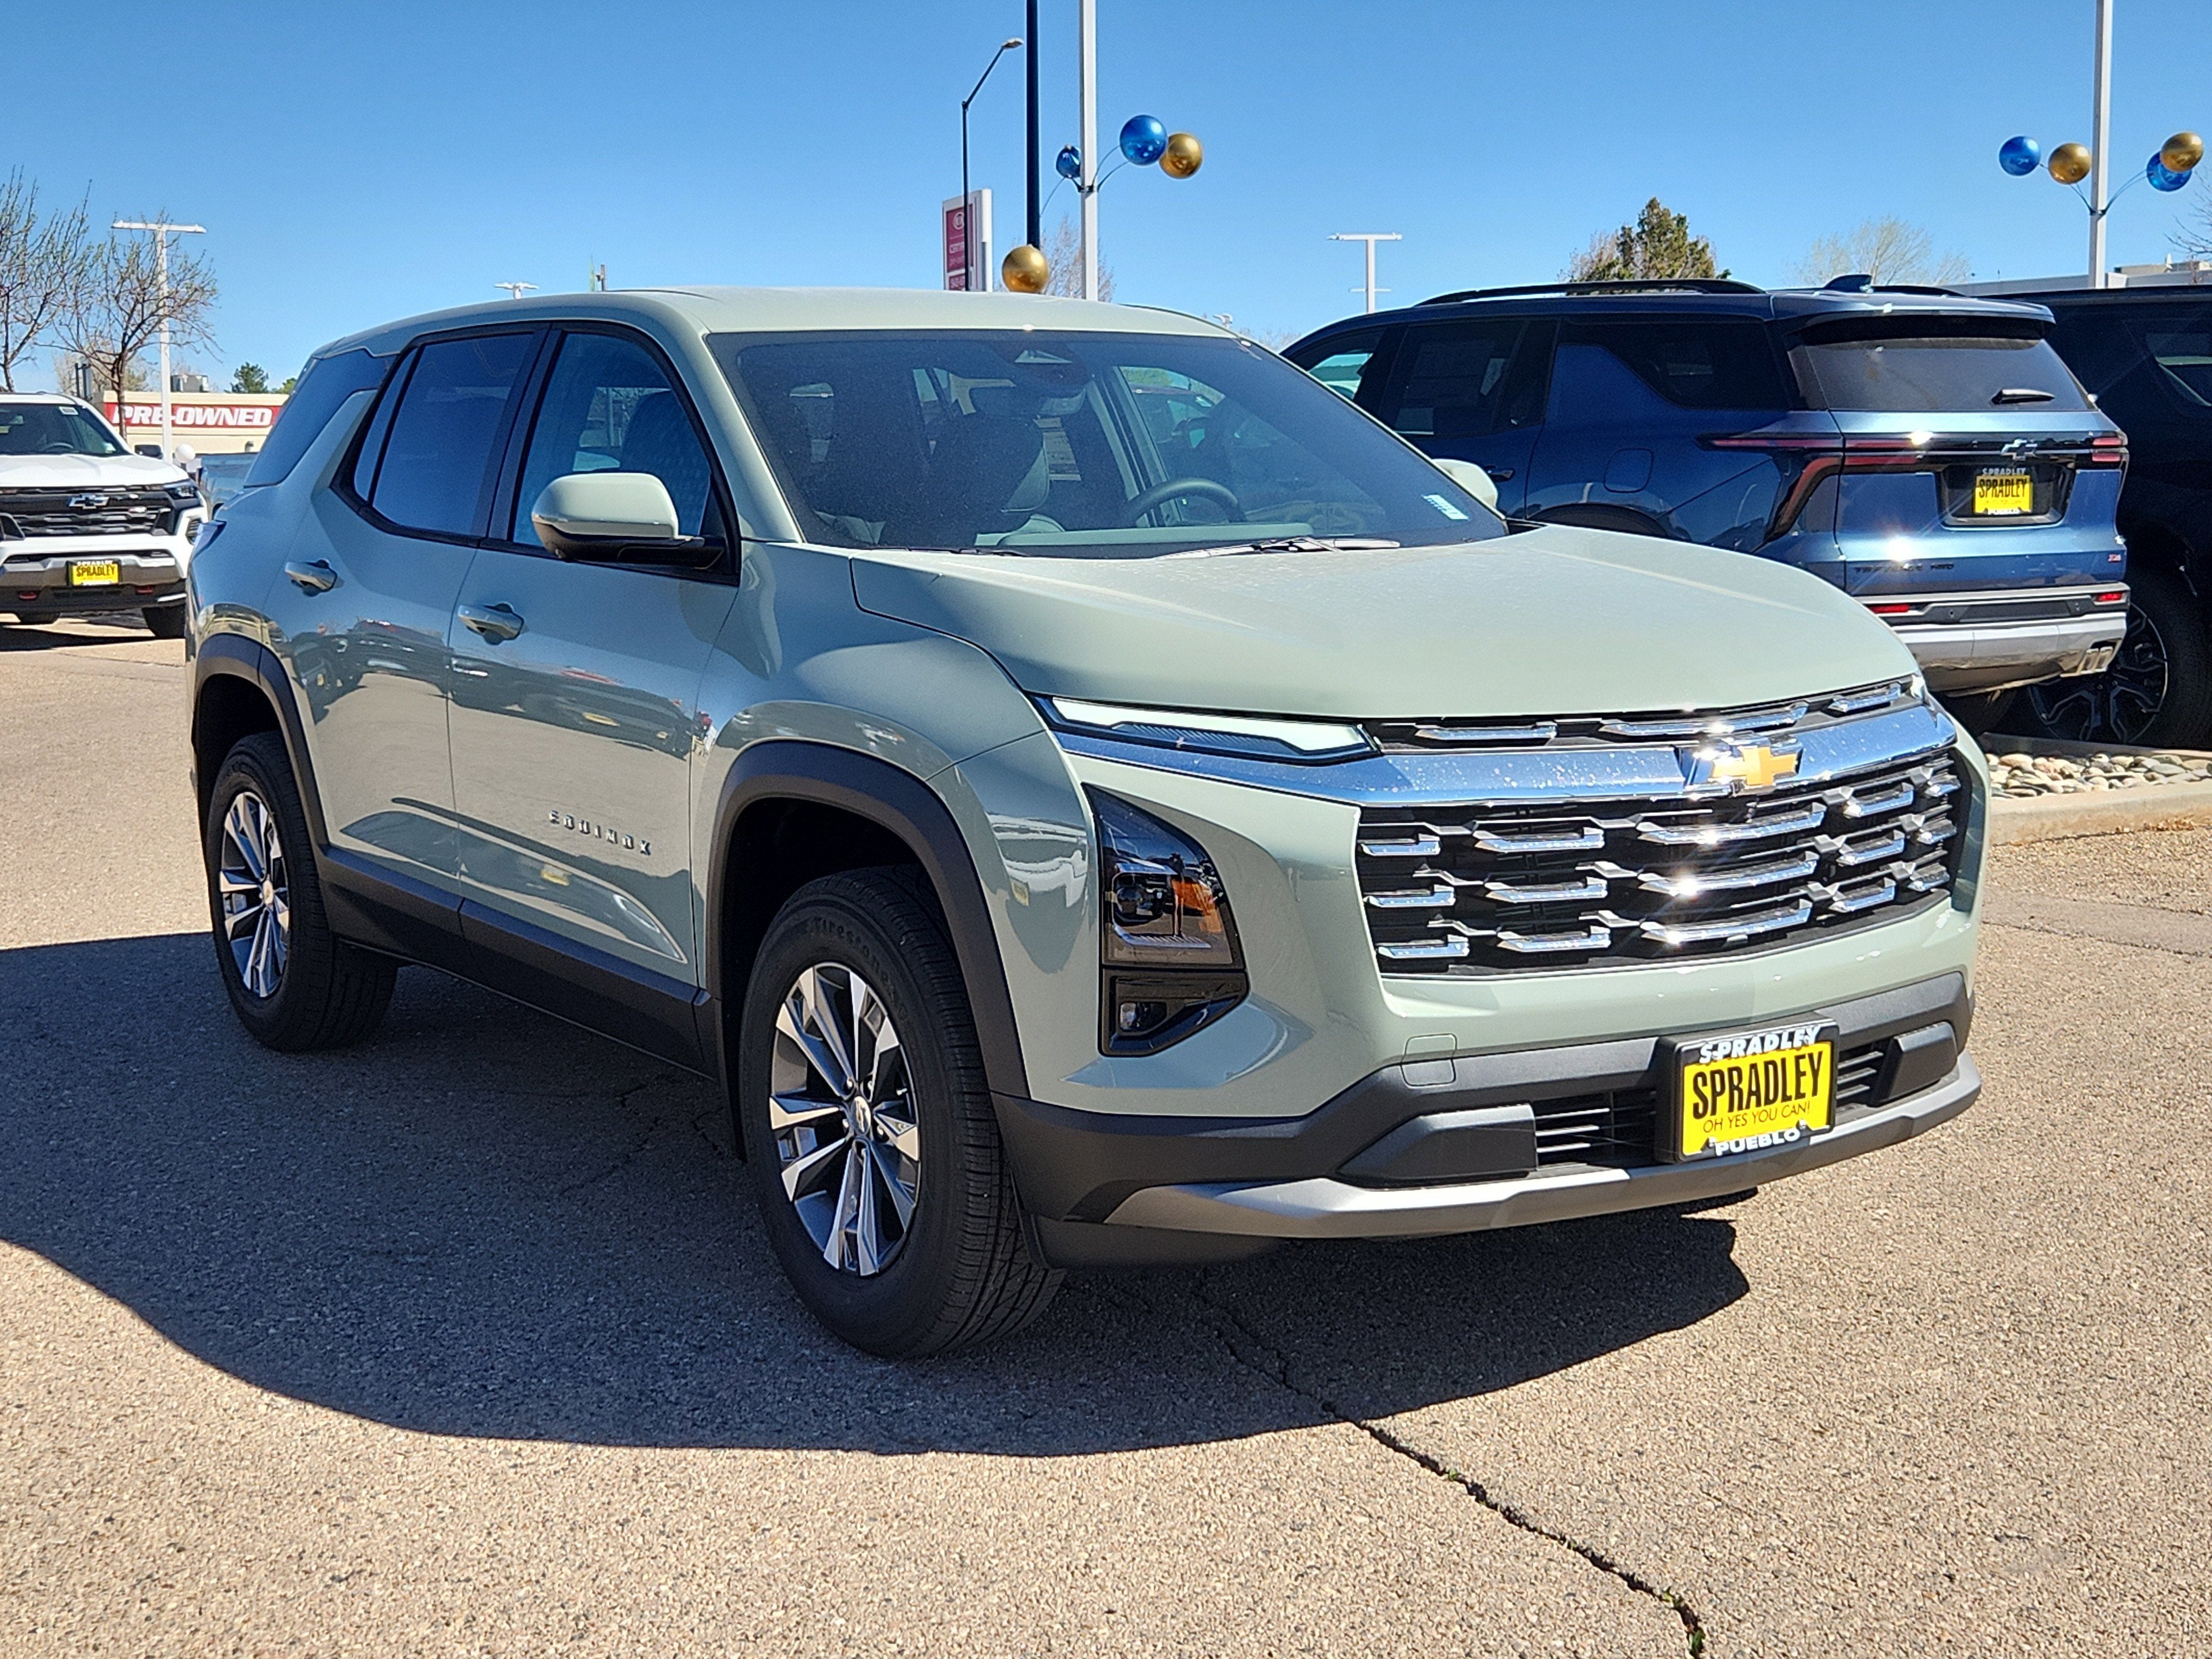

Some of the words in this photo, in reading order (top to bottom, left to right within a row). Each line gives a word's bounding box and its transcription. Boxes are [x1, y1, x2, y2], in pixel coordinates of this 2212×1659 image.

[112, 405, 272, 426] PRE-OWNED
[1979, 478, 2028, 498] SPRADLEY
[76, 565, 115, 577] SPRADLEY
[549, 810, 651, 856] EQUINOX
[1699, 1025, 1821, 1064] SPRADLEY
[1692, 1050, 1824, 1120] SPRADLEY
[1703, 1117, 1724, 1133] OH
[1728, 1113, 1748, 1129] YES
[1752, 1108, 1778, 1124] YOU
[1781, 1101, 1811, 1118] CAN!
[1715, 1127, 1801, 1156] PUEBLO
